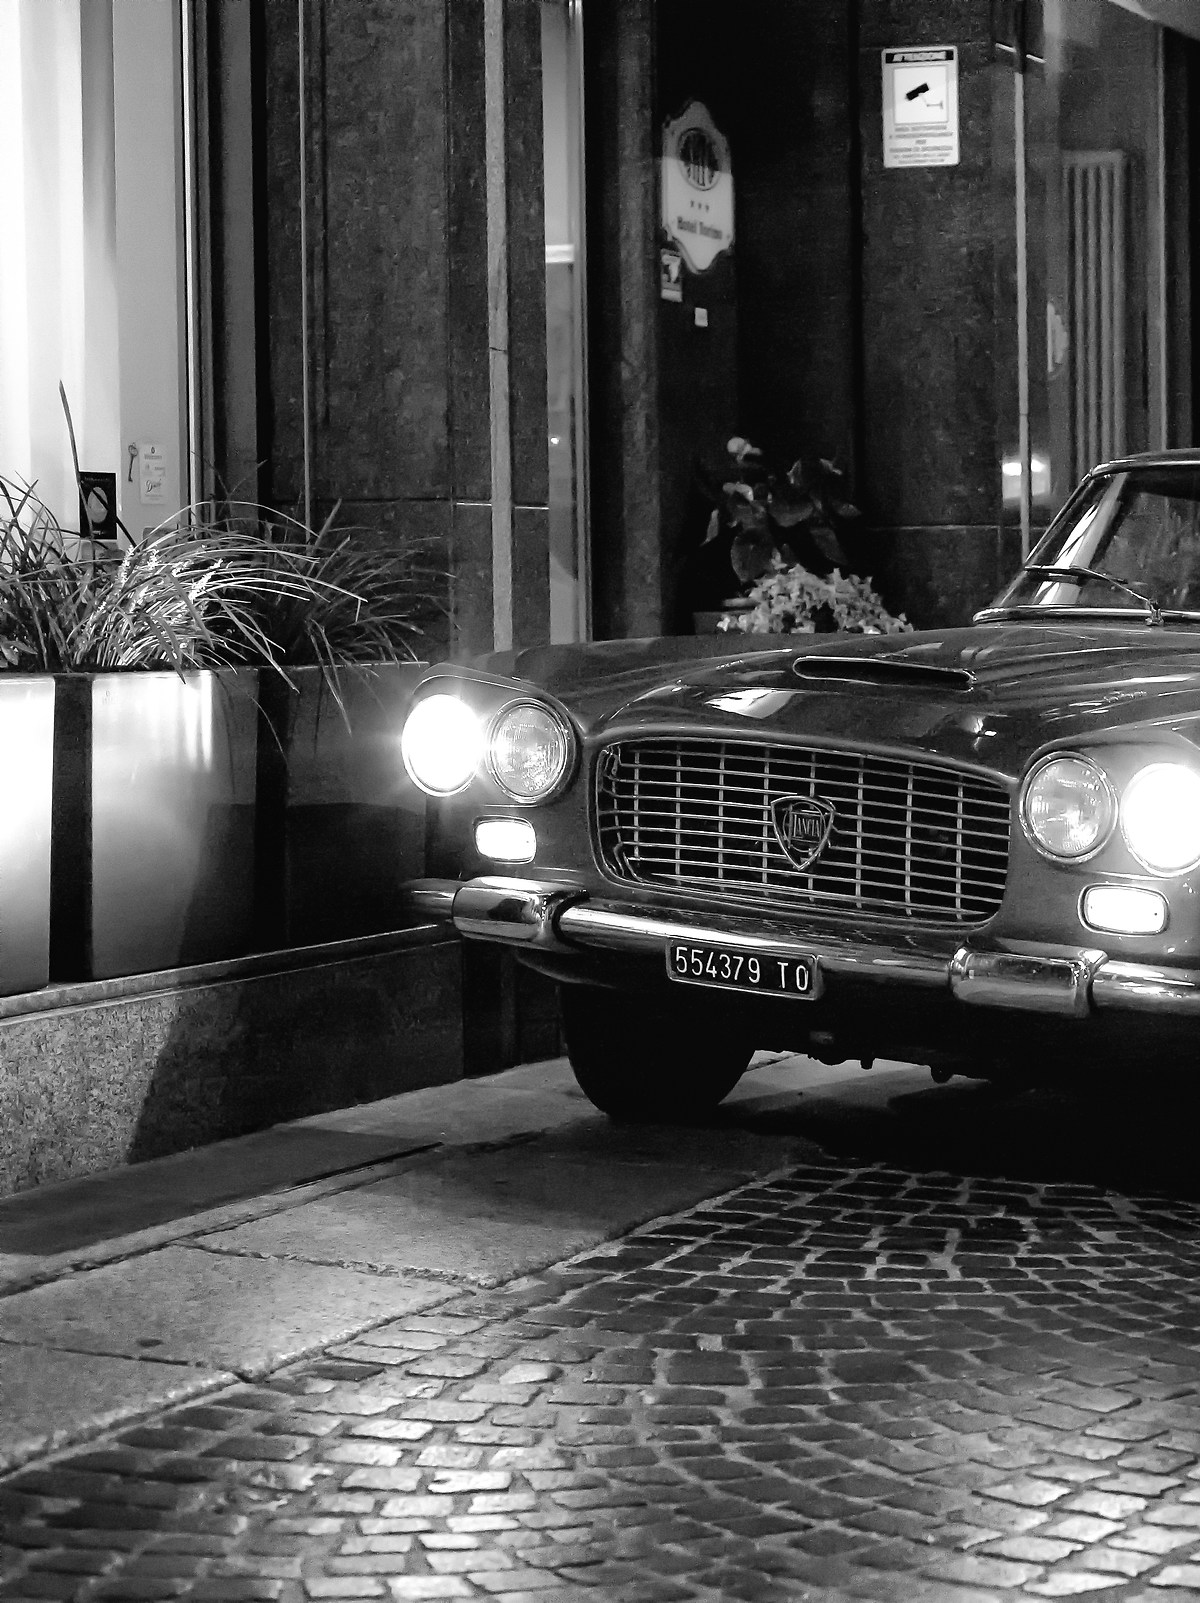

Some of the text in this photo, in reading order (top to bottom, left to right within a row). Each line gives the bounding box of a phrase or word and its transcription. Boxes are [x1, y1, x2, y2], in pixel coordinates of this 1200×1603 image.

[677, 216, 697, 234] Hotel
[675, 946, 809, 991] 554379 TO
